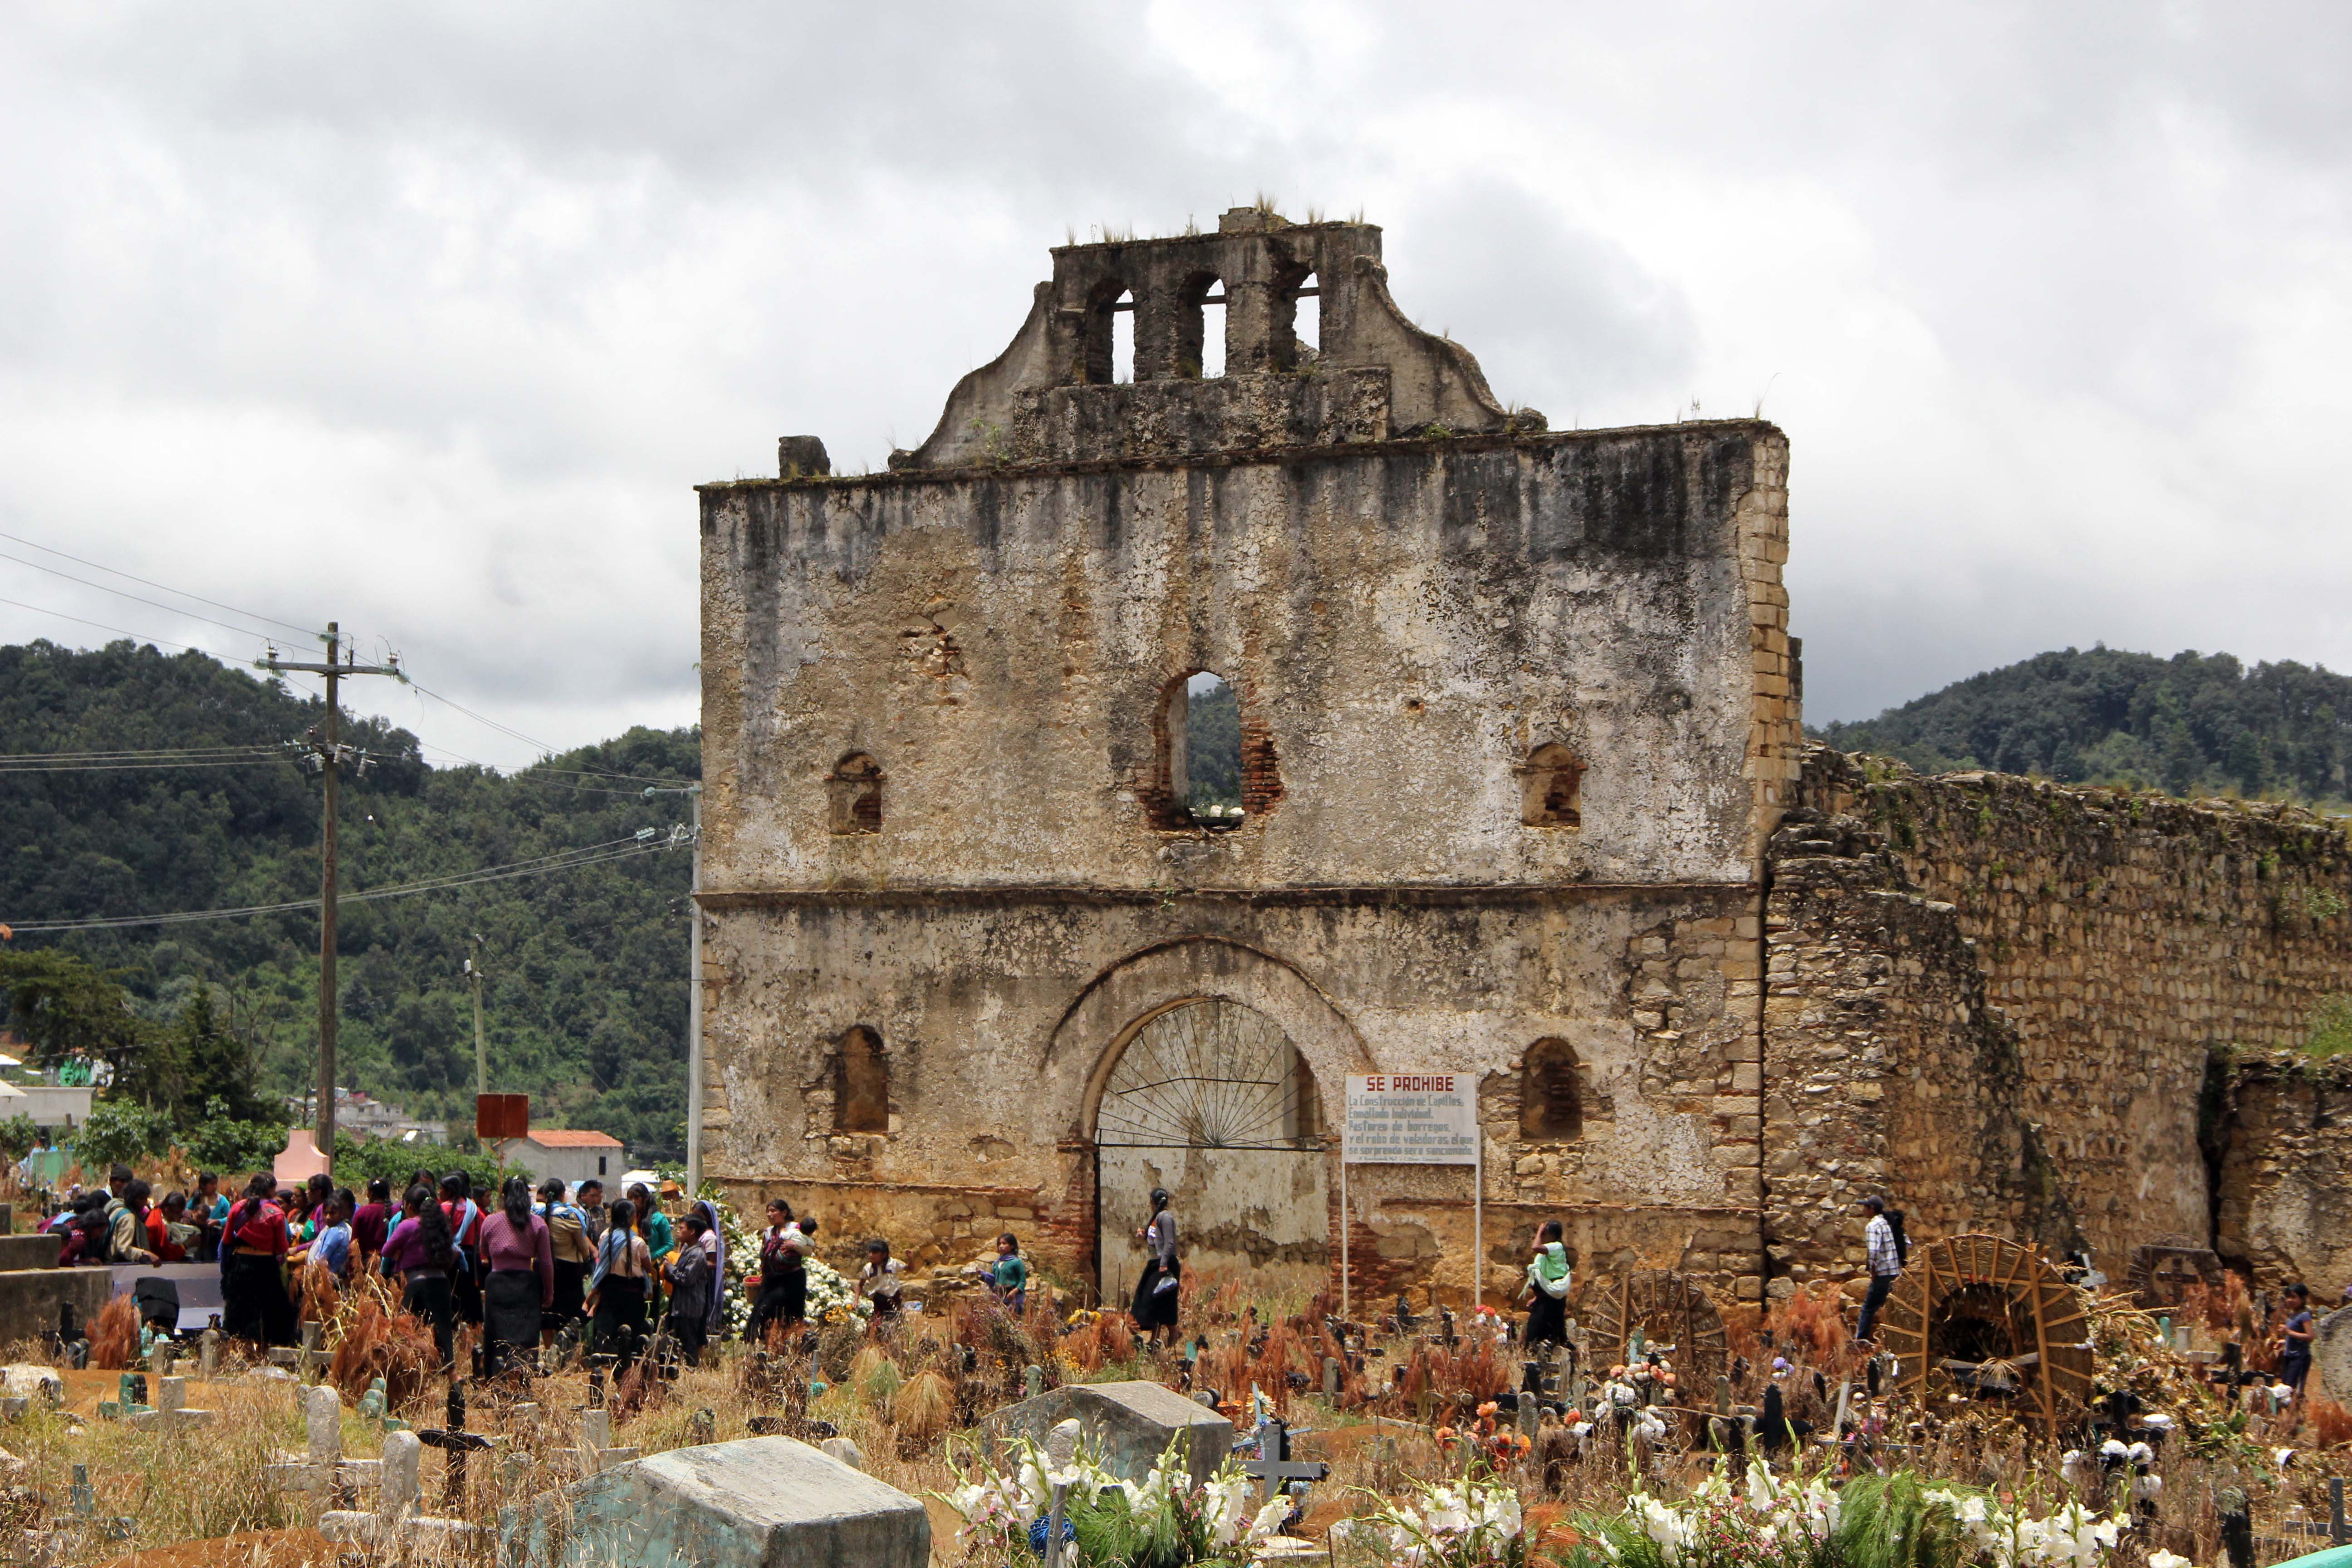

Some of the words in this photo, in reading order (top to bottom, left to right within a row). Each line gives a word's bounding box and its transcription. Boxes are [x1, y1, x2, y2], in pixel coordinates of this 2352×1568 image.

[1367, 1077, 1385, 1091] SE
[1393, 1077, 1454, 1091] PROHIBE
[1349, 1094, 1358, 1106] La
[1417, 1095, 1426, 1106] de
[1392, 1120, 1402, 1131] de
[1349, 1136, 1354, 1144] y
[1356, 1132, 1363, 1144] el
[1367, 1132, 1387, 1144] robo
[1390, 1132, 1401, 1144] de
[1451, 1133, 1459, 1144] el
[1460, 1137, 1474, 1146] que
